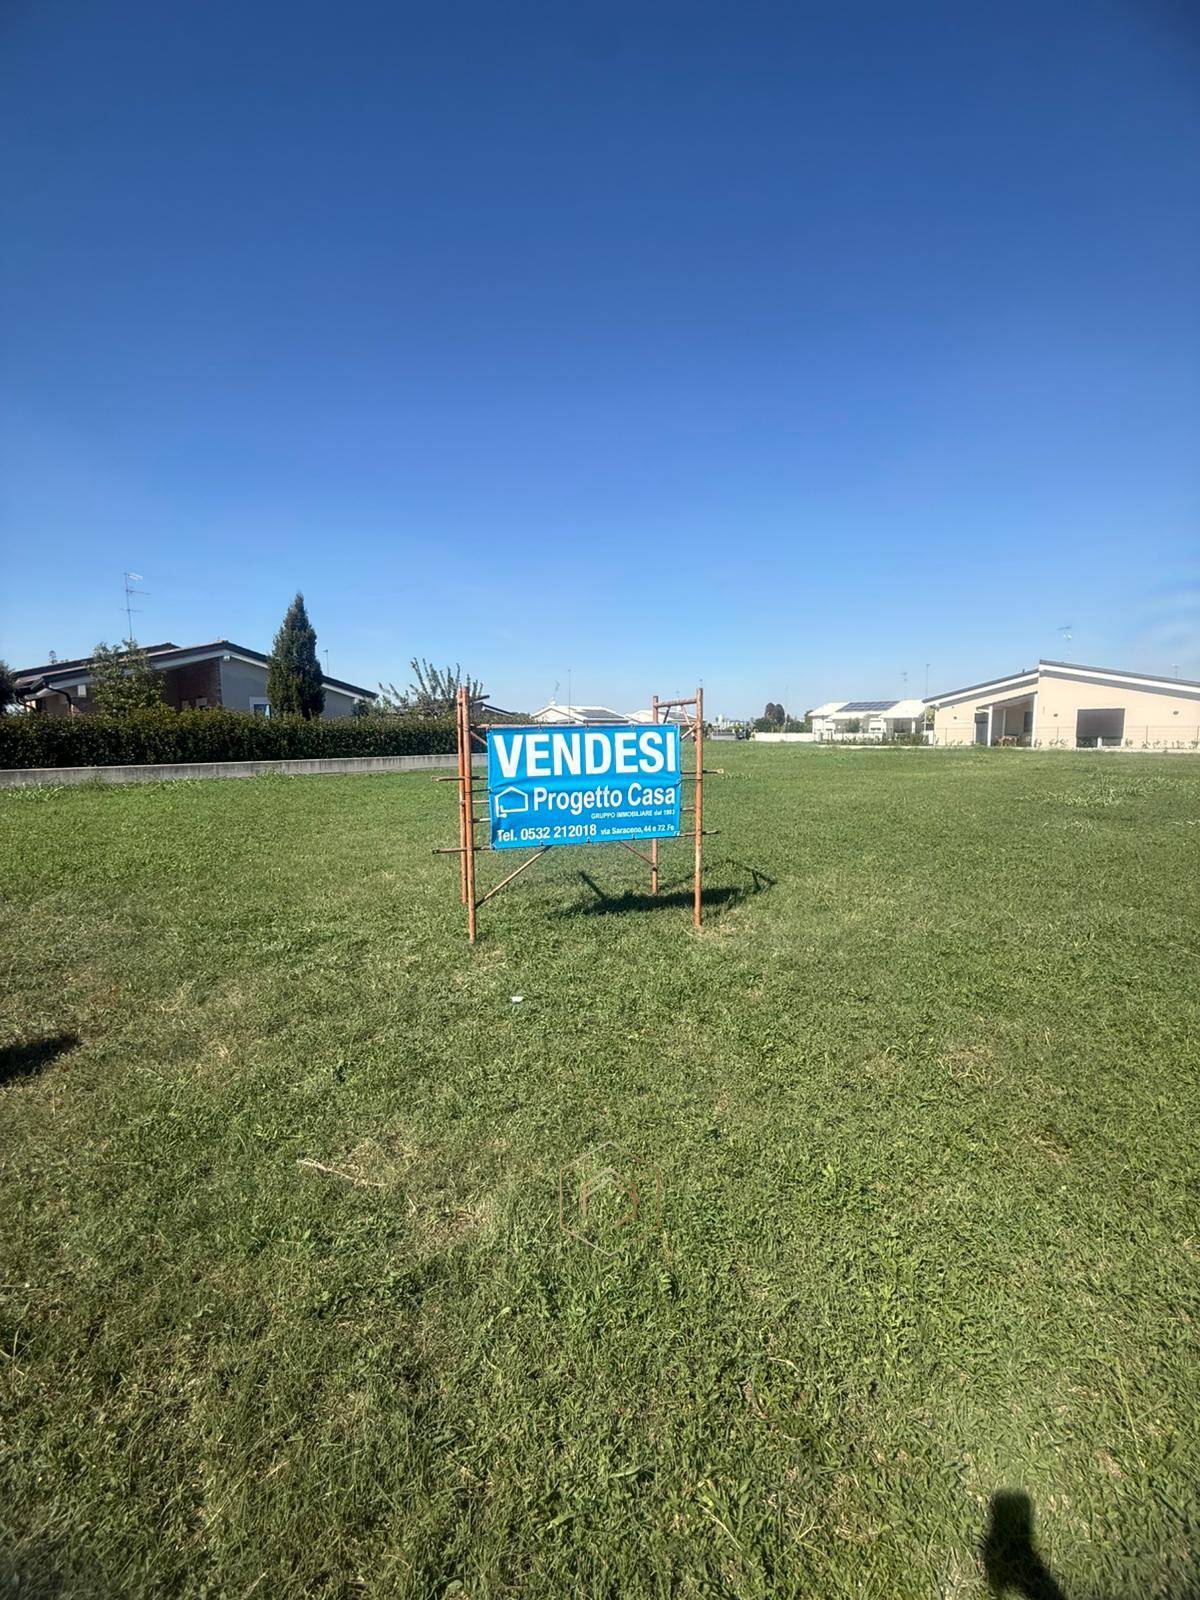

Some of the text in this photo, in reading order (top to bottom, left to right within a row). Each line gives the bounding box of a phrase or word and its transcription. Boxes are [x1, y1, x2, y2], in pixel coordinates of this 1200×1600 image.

[493, 731, 676, 778] VENDESI
[533, 782, 675, 815] Progetto Casa
[616, 810, 653, 818] IMMOBILIARE
[497, 829, 518, 841] Tel.
[520, 826, 550, 841] 0532
[553, 824, 597, 839] 212018
[611, 825, 643, 835] Saraceno,
[667, 823, 675, 831] Fe
